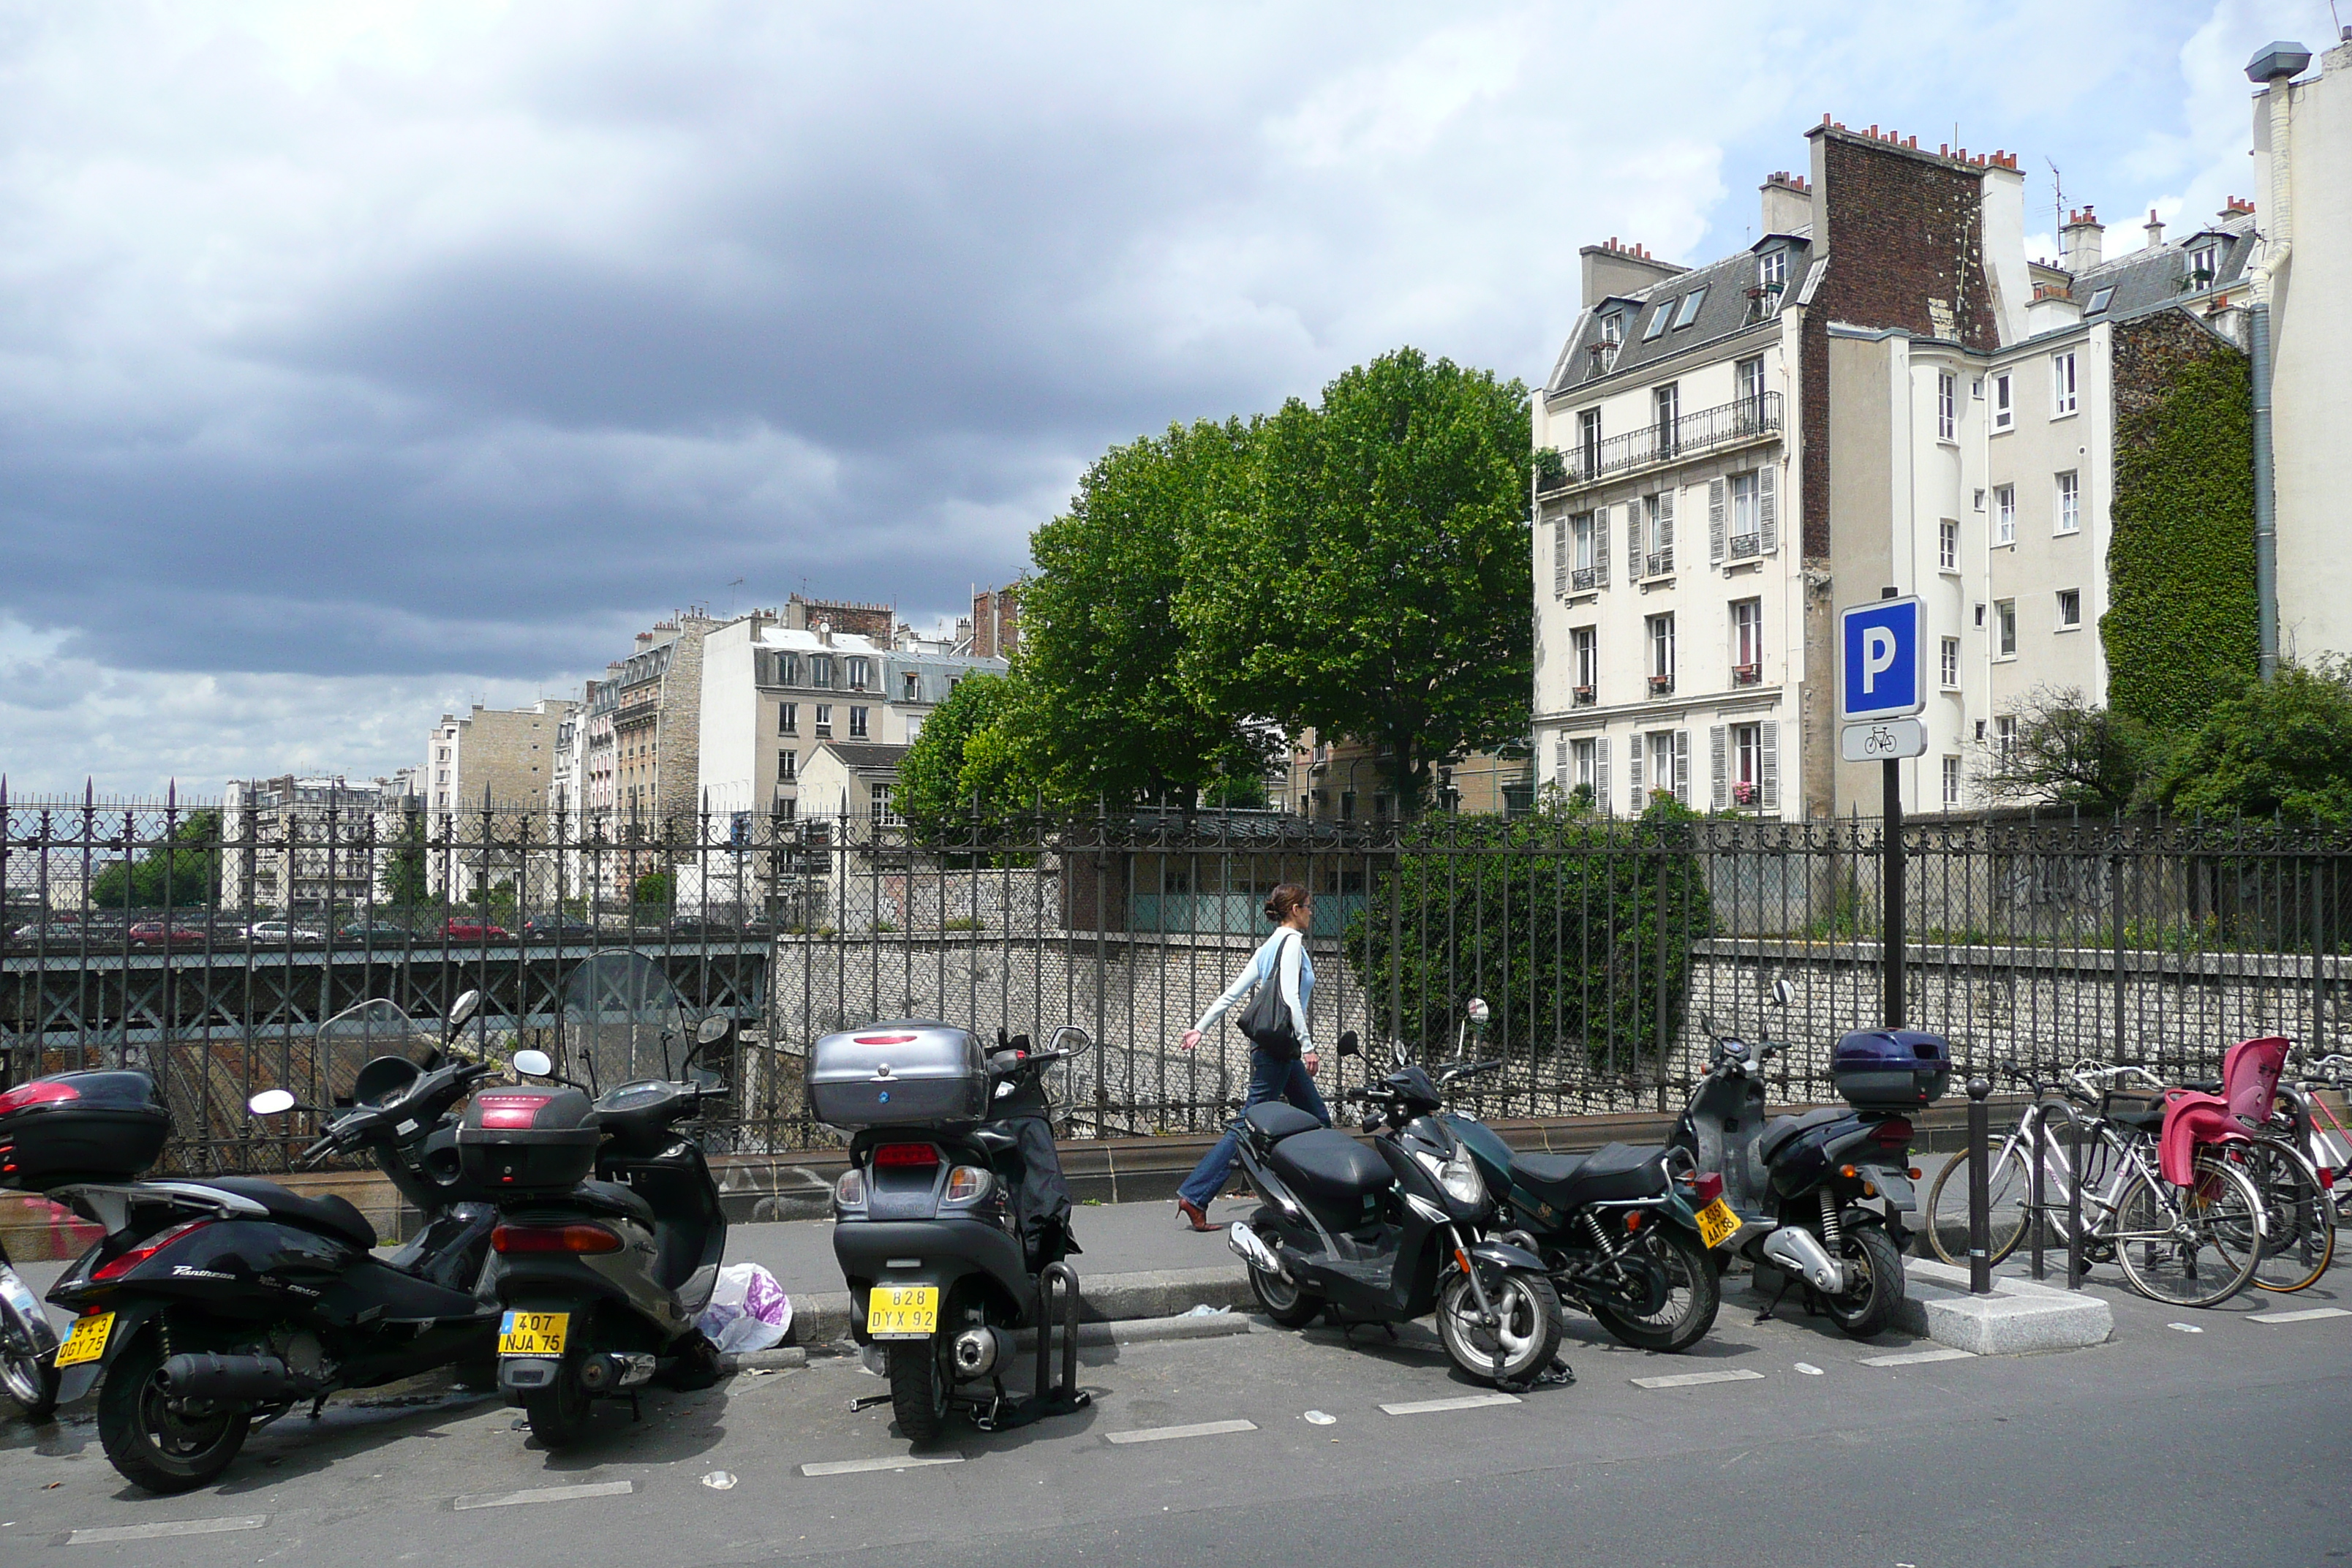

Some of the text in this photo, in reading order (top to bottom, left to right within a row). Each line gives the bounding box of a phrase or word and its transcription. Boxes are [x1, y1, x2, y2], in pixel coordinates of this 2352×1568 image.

[1863, 625, 1896, 694] P
[1705, 1205, 1722, 1225] 835
[1720, 1217, 1735, 1233] 38
[893, 1290, 925, 1306] 828
[75, 1317, 108, 1338] 943
[519, 1314, 553, 1331] 407
[872, 1311, 933, 1327] DYX 92
[85, 1335, 105, 1354] 75
[505, 1334, 560, 1352] NJA 75
